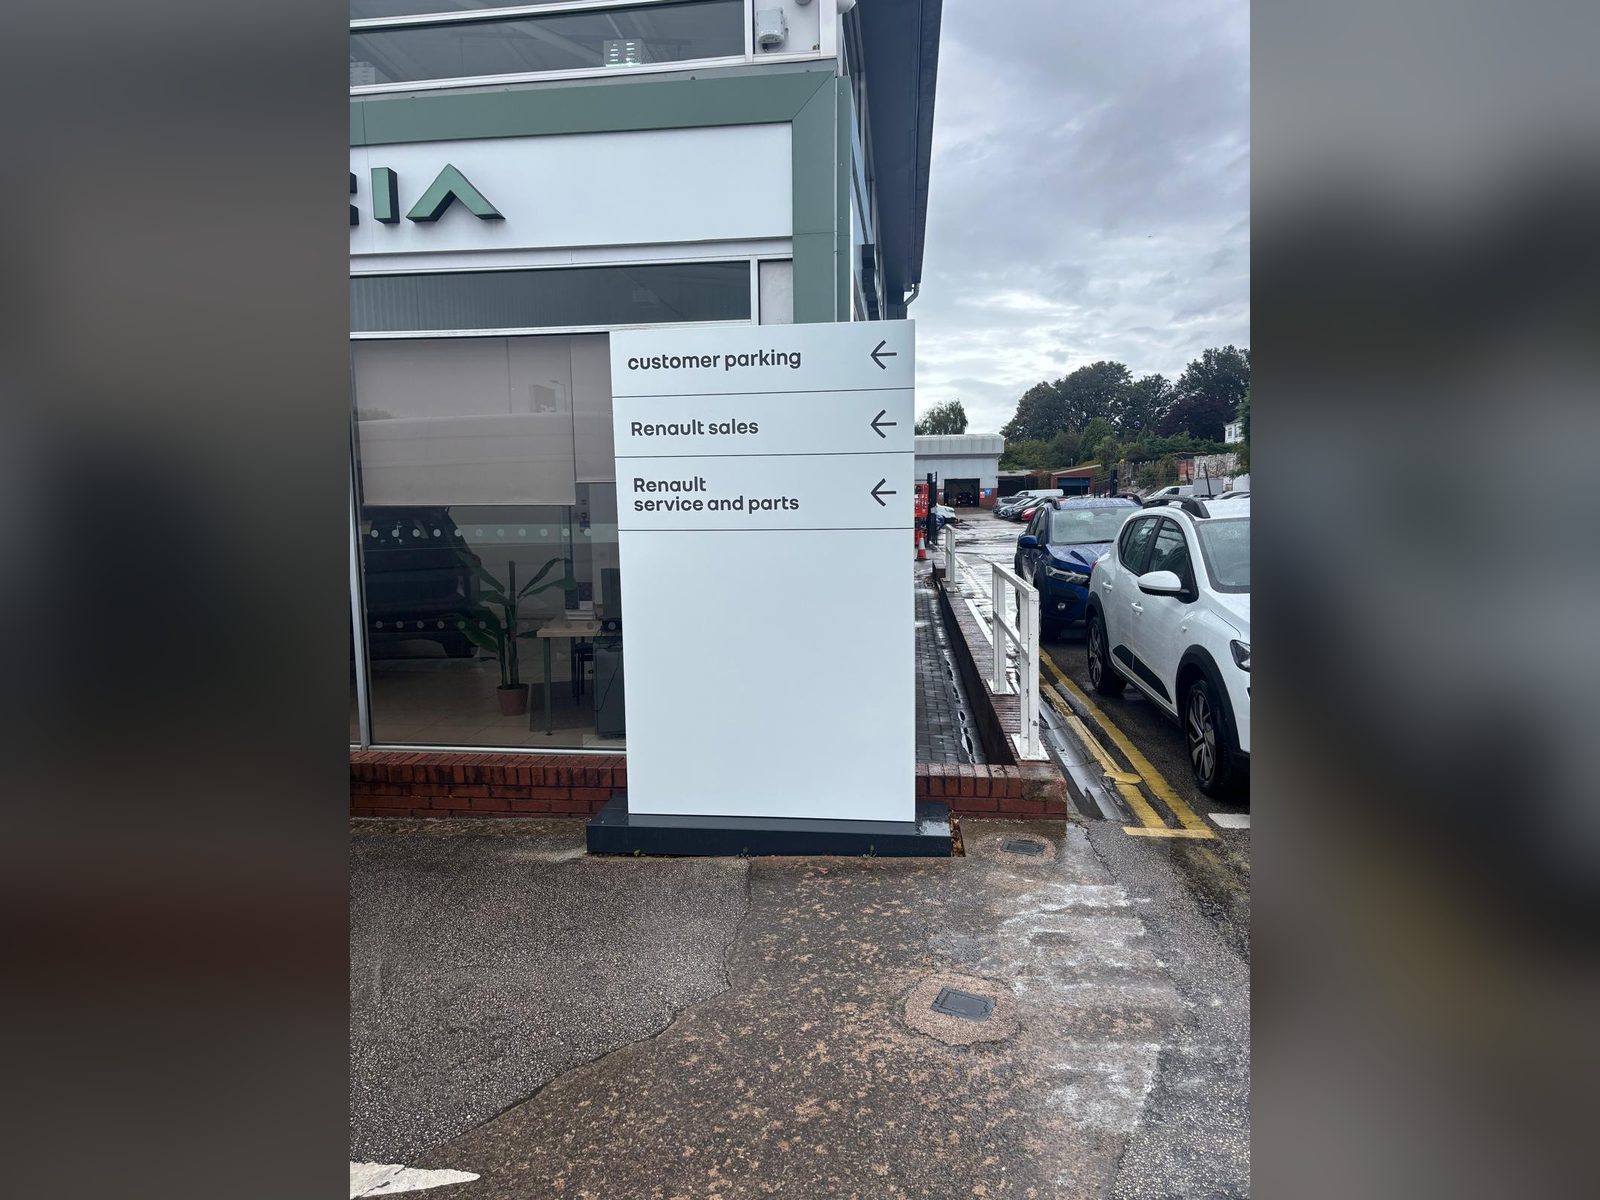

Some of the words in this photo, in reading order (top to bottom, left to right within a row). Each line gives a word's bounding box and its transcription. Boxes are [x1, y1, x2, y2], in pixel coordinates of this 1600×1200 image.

[350, 163, 505, 225] IA
[627, 354, 721, 371] customer
[724, 349, 801, 372] parking
[631, 419, 705, 437] Renault
[708, 418, 759, 435] sales
[633, 476, 707, 493] Renault
[634, 496, 704, 512] service
[707, 495, 744, 511] and
[748, 496, 800, 514] parts
